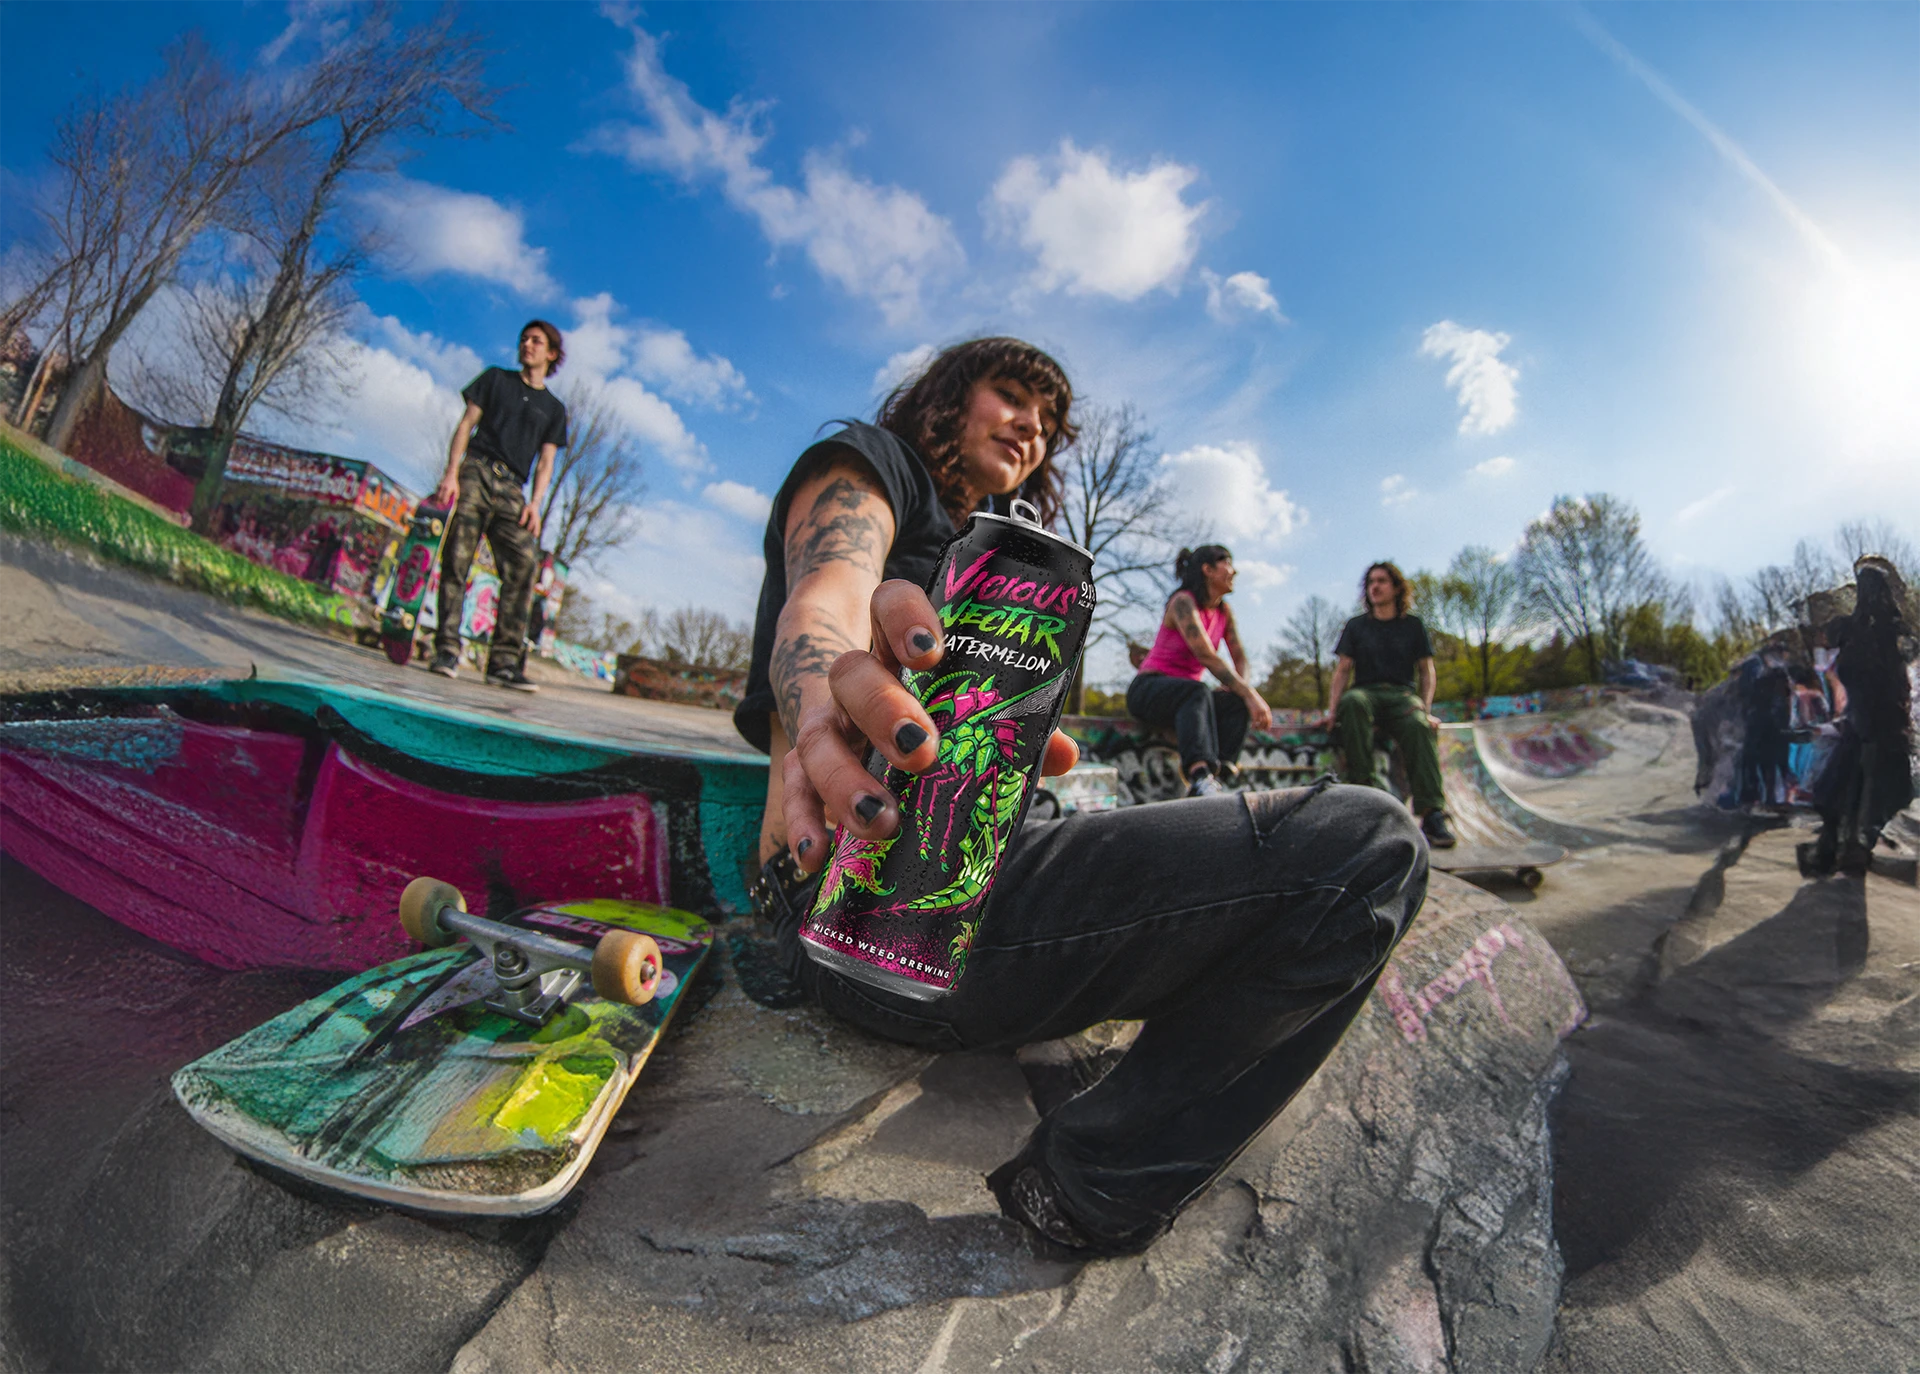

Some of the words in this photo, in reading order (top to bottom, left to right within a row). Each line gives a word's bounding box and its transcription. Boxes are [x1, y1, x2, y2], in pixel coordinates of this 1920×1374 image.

[944, 547, 1078, 615] VICIOUS
[939, 596, 1067, 665] NECTAR
[813, 923, 854, 945] WICKED
[858, 941, 895, 960] WEED
[899, 957, 950, 979] BREWING
